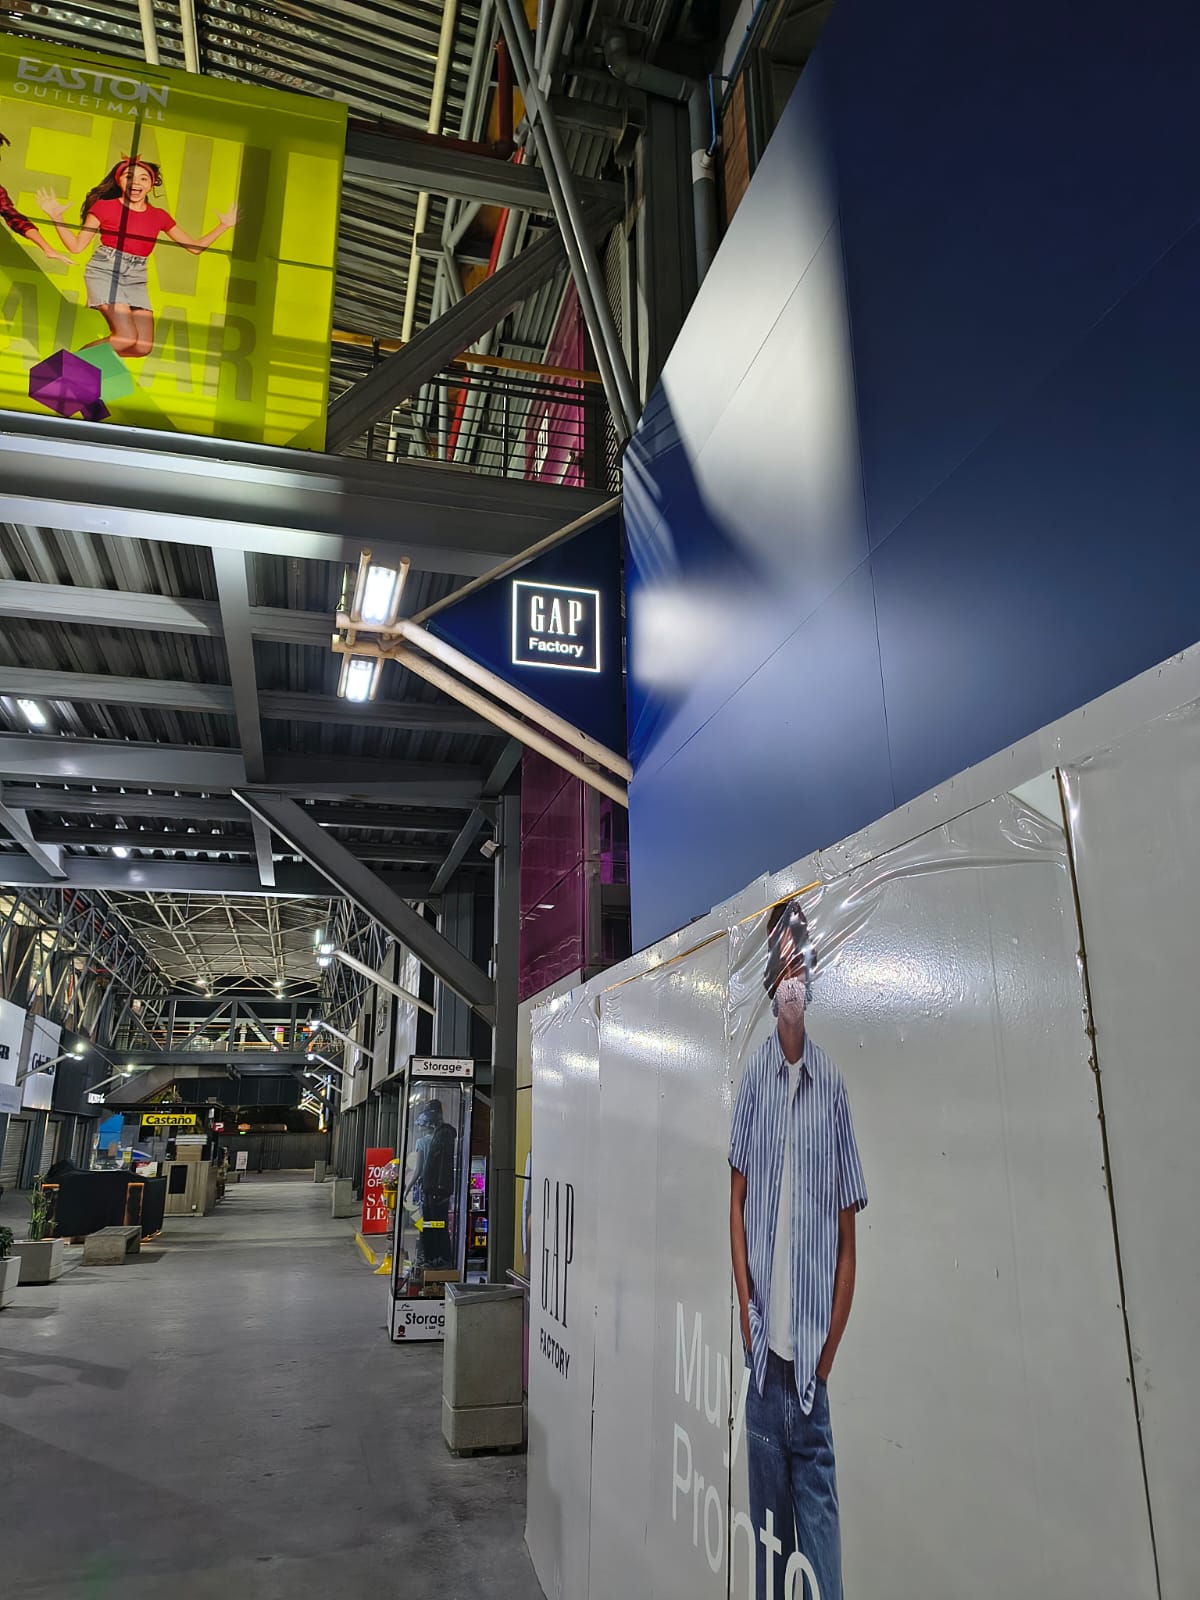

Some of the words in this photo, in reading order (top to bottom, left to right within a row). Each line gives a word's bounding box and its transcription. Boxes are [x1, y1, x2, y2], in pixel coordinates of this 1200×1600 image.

[17, 56, 169, 108] EASTON
[530, 595, 582, 636] GAP
[529, 637, 584, 658] Factory
[423, 1061, 462, 1073] Storage
[146, 1114, 192, 1125] Castaño
[367, 1178, 383, 1187] OF
[541, 1177, 575, 1328] GAP
[404, 1312, 445, 1327] Storag
[540, 1327, 570, 1379] FACTORY
[673, 1301, 751, 1469] Muy
